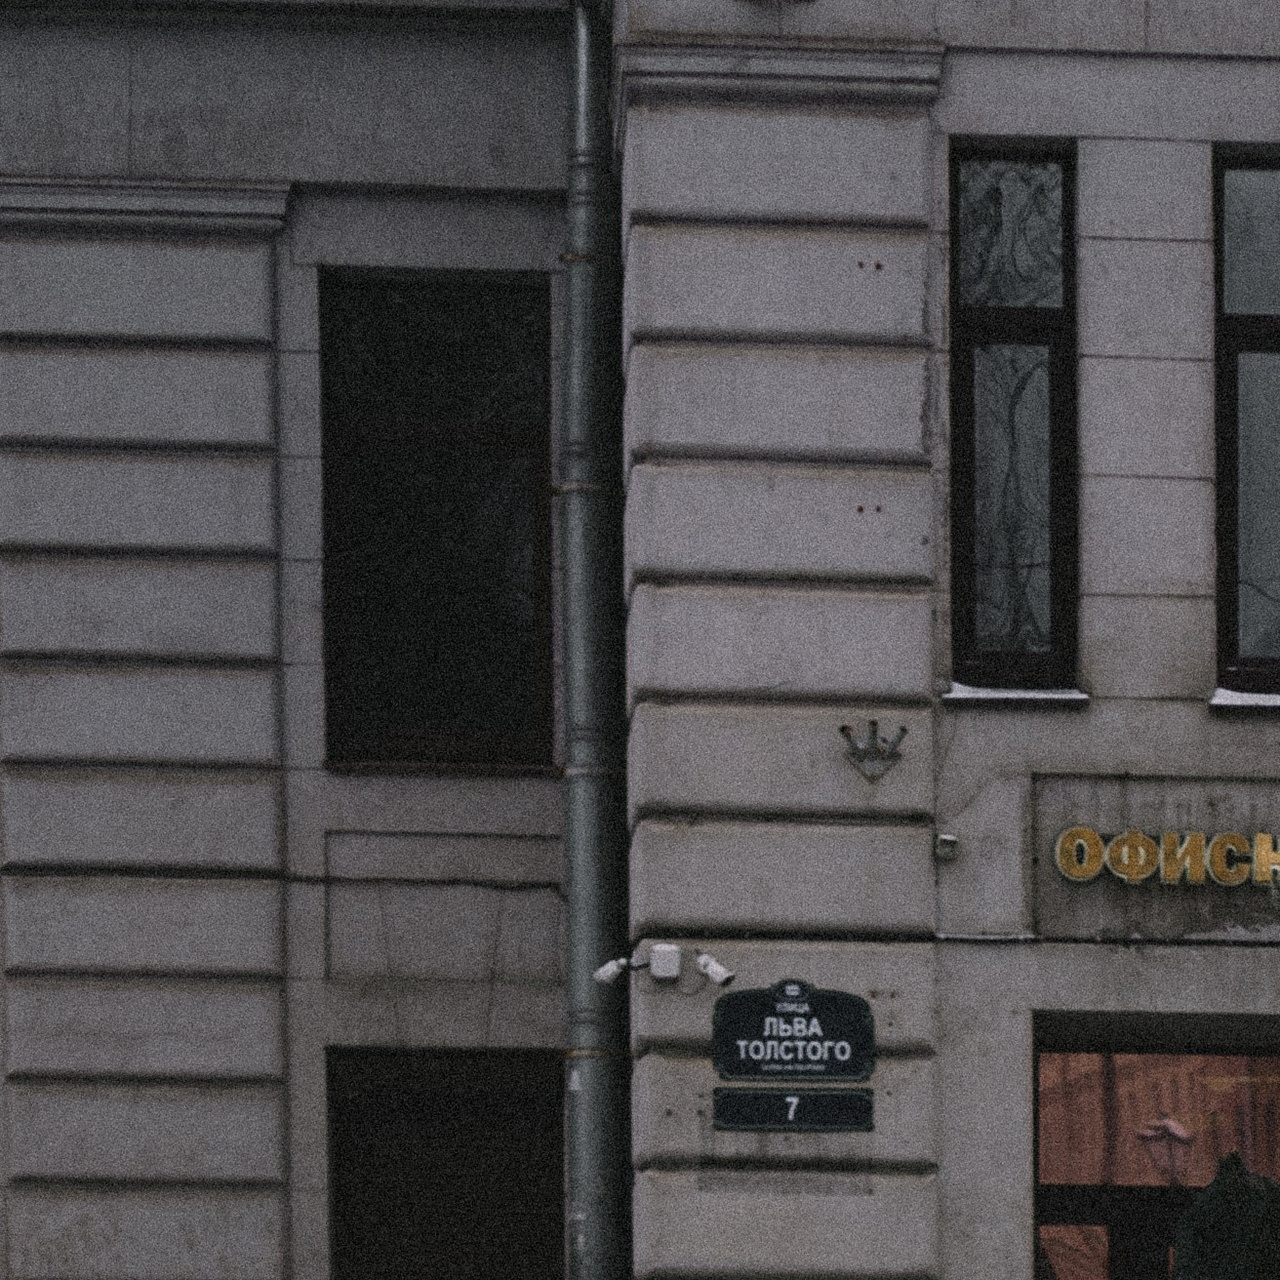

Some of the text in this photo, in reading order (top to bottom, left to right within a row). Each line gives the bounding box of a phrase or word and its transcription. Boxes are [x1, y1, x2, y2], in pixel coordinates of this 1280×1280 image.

[762, 1016, 824, 1037] ЛЬВА
[736, 1039, 851, 1061] ТОЛСТОГО
[785, 1096, 799, 1121] 7
